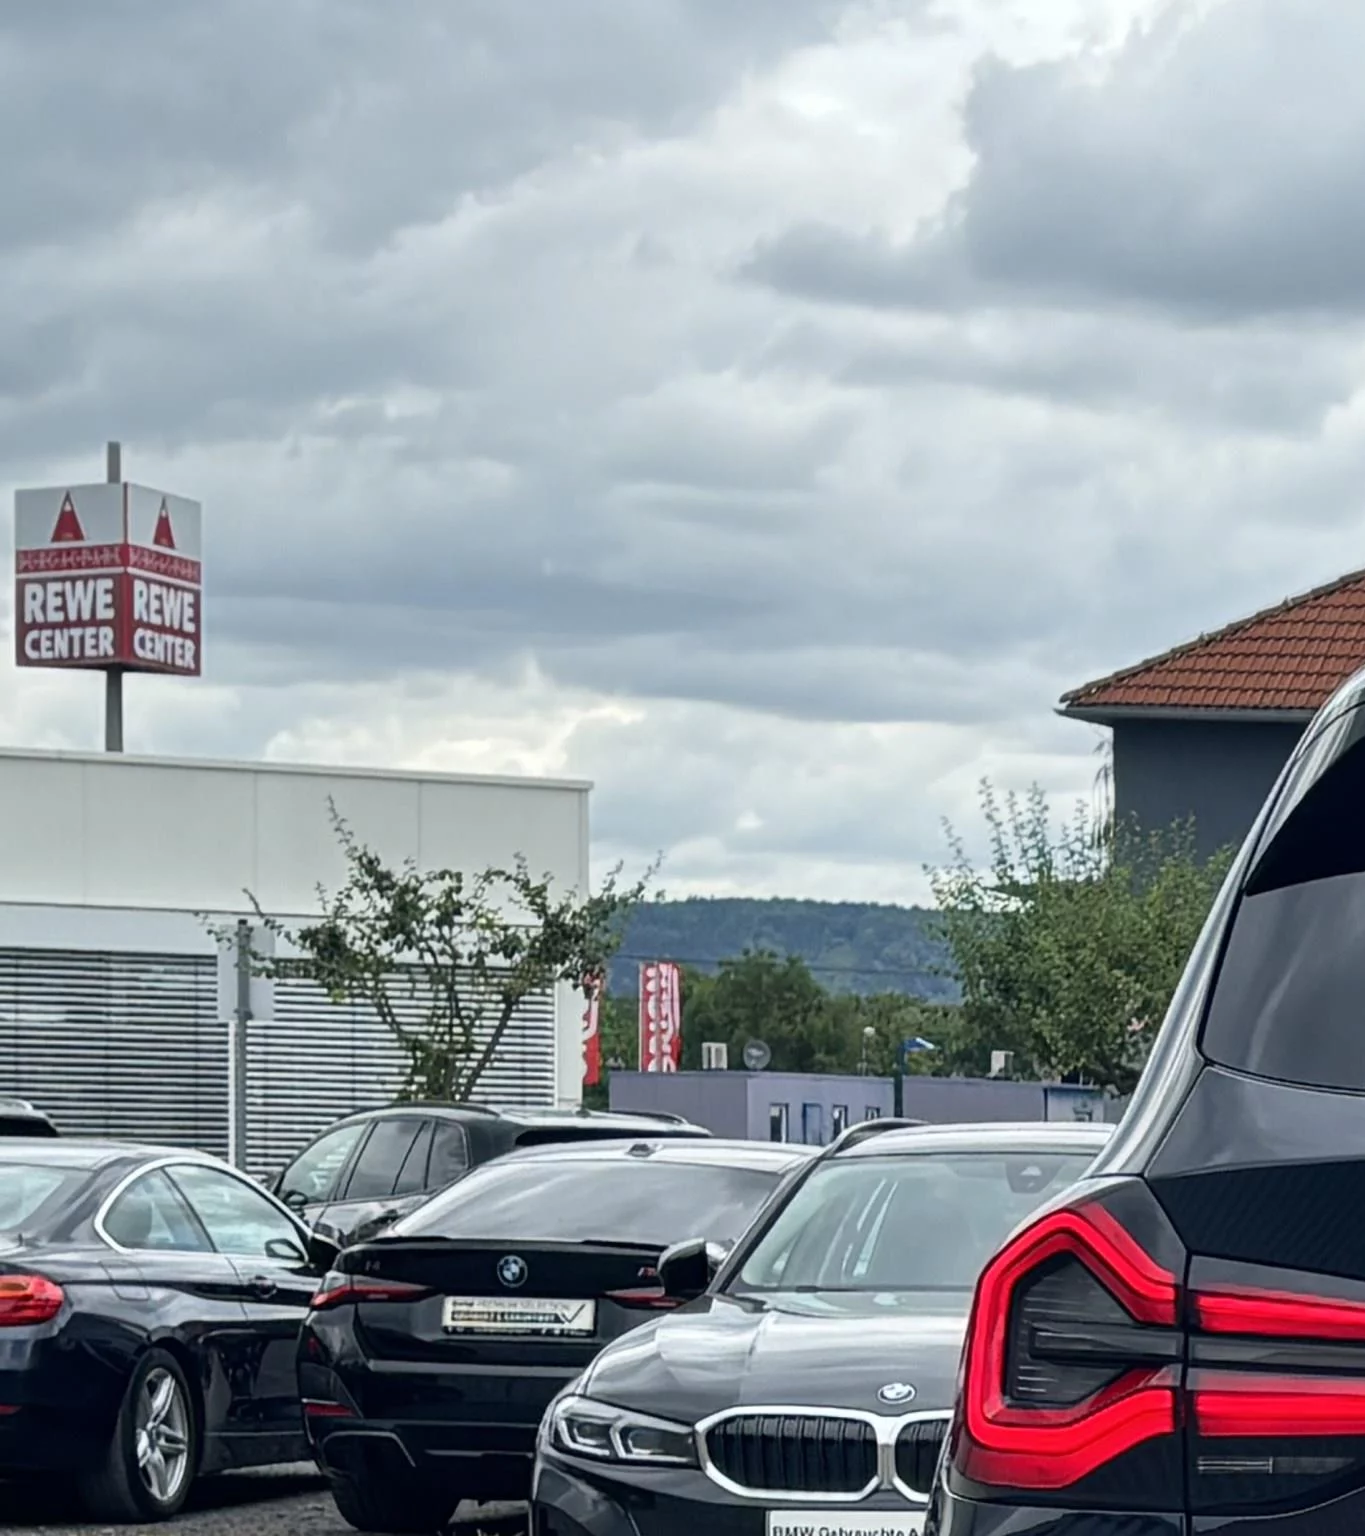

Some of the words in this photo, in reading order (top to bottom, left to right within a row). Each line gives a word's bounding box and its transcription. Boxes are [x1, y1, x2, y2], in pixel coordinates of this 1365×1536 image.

[24, 578, 115, 624] REWE
[133, 579, 195, 633] REWE
[25, 626, 115, 660] CENTER
[133, 628, 195, 669] CENTER
